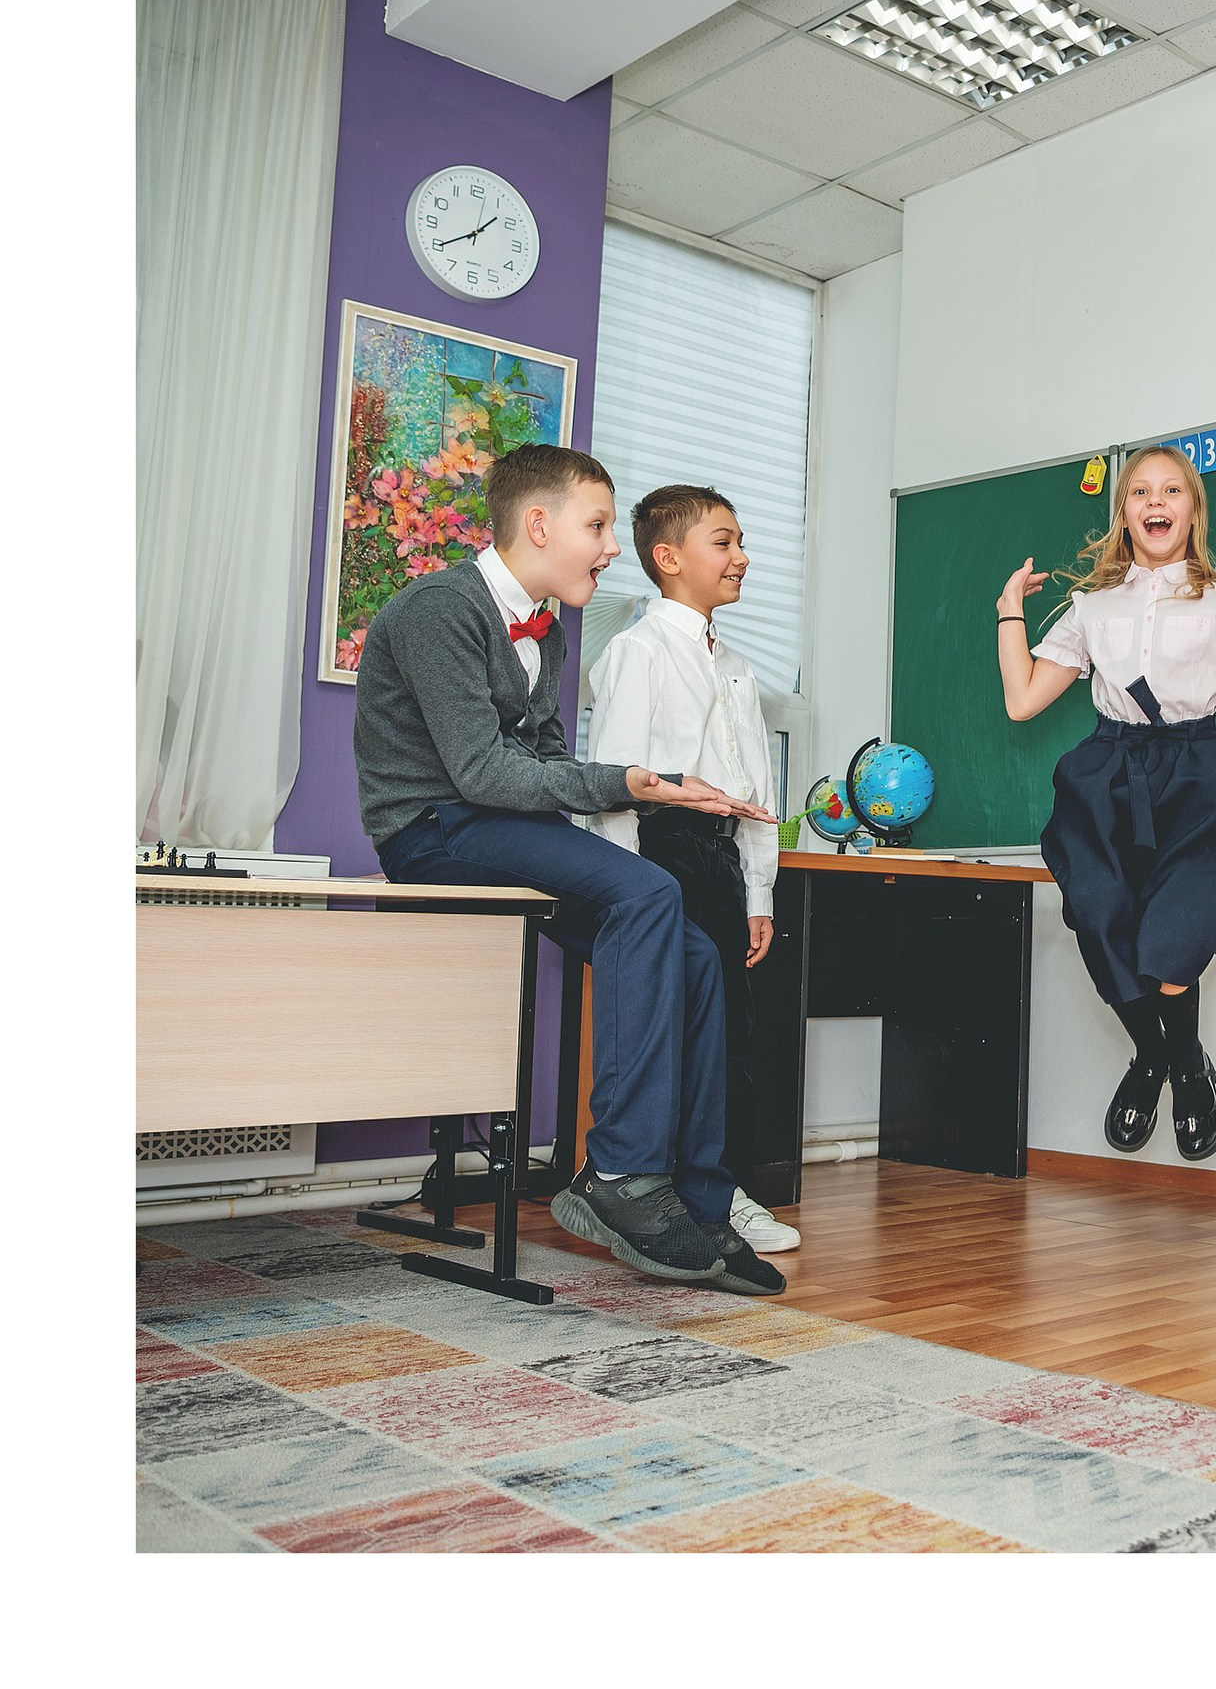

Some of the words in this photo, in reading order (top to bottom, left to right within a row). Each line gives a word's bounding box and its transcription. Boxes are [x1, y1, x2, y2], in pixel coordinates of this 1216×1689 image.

[453, 184, 460, 198] 11
[471, 184, 485, 199] 12
[434, 196, 449, 211] 10
[496, 197, 500, 209] 1
[426, 215, 438, 229] 9
[504, 216, 517, 231] 2
[432, 238, 444, 252] 8
[511, 239, 522, 254] 3
[447, 258, 457, 271] 7
[503, 260, 514, 271] 4
[468, 271, 478, 284] 6
[487, 269, 499, 283] 5
[1185, 443, 1196, 465] 2
[1204, 438, 1216, 467] 3
